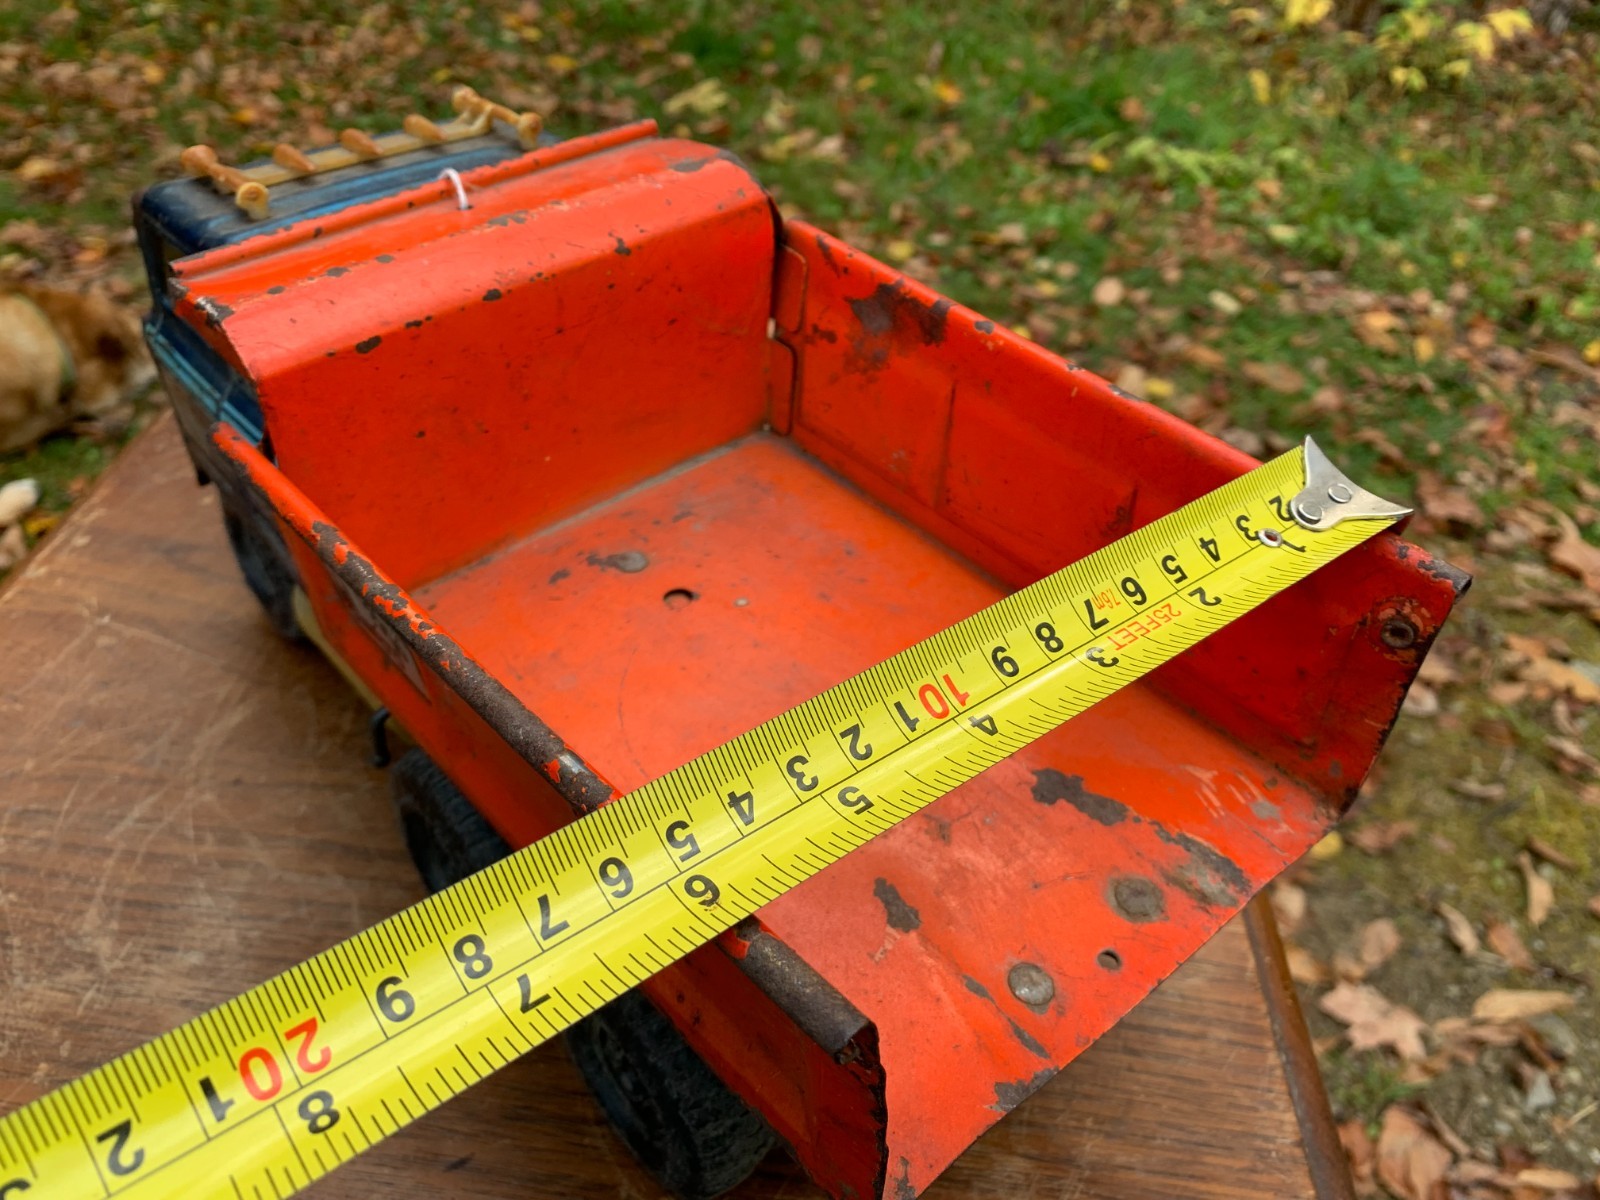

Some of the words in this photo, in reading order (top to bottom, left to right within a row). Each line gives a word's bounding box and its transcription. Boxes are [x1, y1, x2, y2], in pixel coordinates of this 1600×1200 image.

[1269, 495, 1294, 521] 2
[1236, 515, 1259, 541] 3
[1199, 537, 1221, 562] 4
[1161, 555, 1188, 584] 5
[1121, 577, 1147, 605] 6
[1188, 587, 1221, 607] 2
[1084, 598, 1109, 630] 7
[1107, 603, 1182, 651] 25FEET
[1034, 621, 1064, 653] 8
[991, 646, 1019, 677] 9
[1085, 647, 1119, 668] 3
[918, 674, 970, 719] 10
[894, 701, 920, 732] 1
[968, 714, 998, 736] 4
[839, 723, 873, 761] 2
[786, 755, 819, 792] 3
[727, 791, 755, 827] 4
[837, 786, 875, 815] 5
[665, 820, 701, 862] 5
[599, 857, 634, 898] 6
[684, 874, 720, 911] 6
[537, 894, 570, 941] 7
[453, 934, 493, 979] 8
[376, 976, 415, 1022] 9
[517, 973, 552, 1014] 7
[239, 1017, 332, 1101] 20
[199, 1076, 234, 1122] 1
[298, 1090, 340, 1134] 8
[96, 1119, 144, 1176] 2
